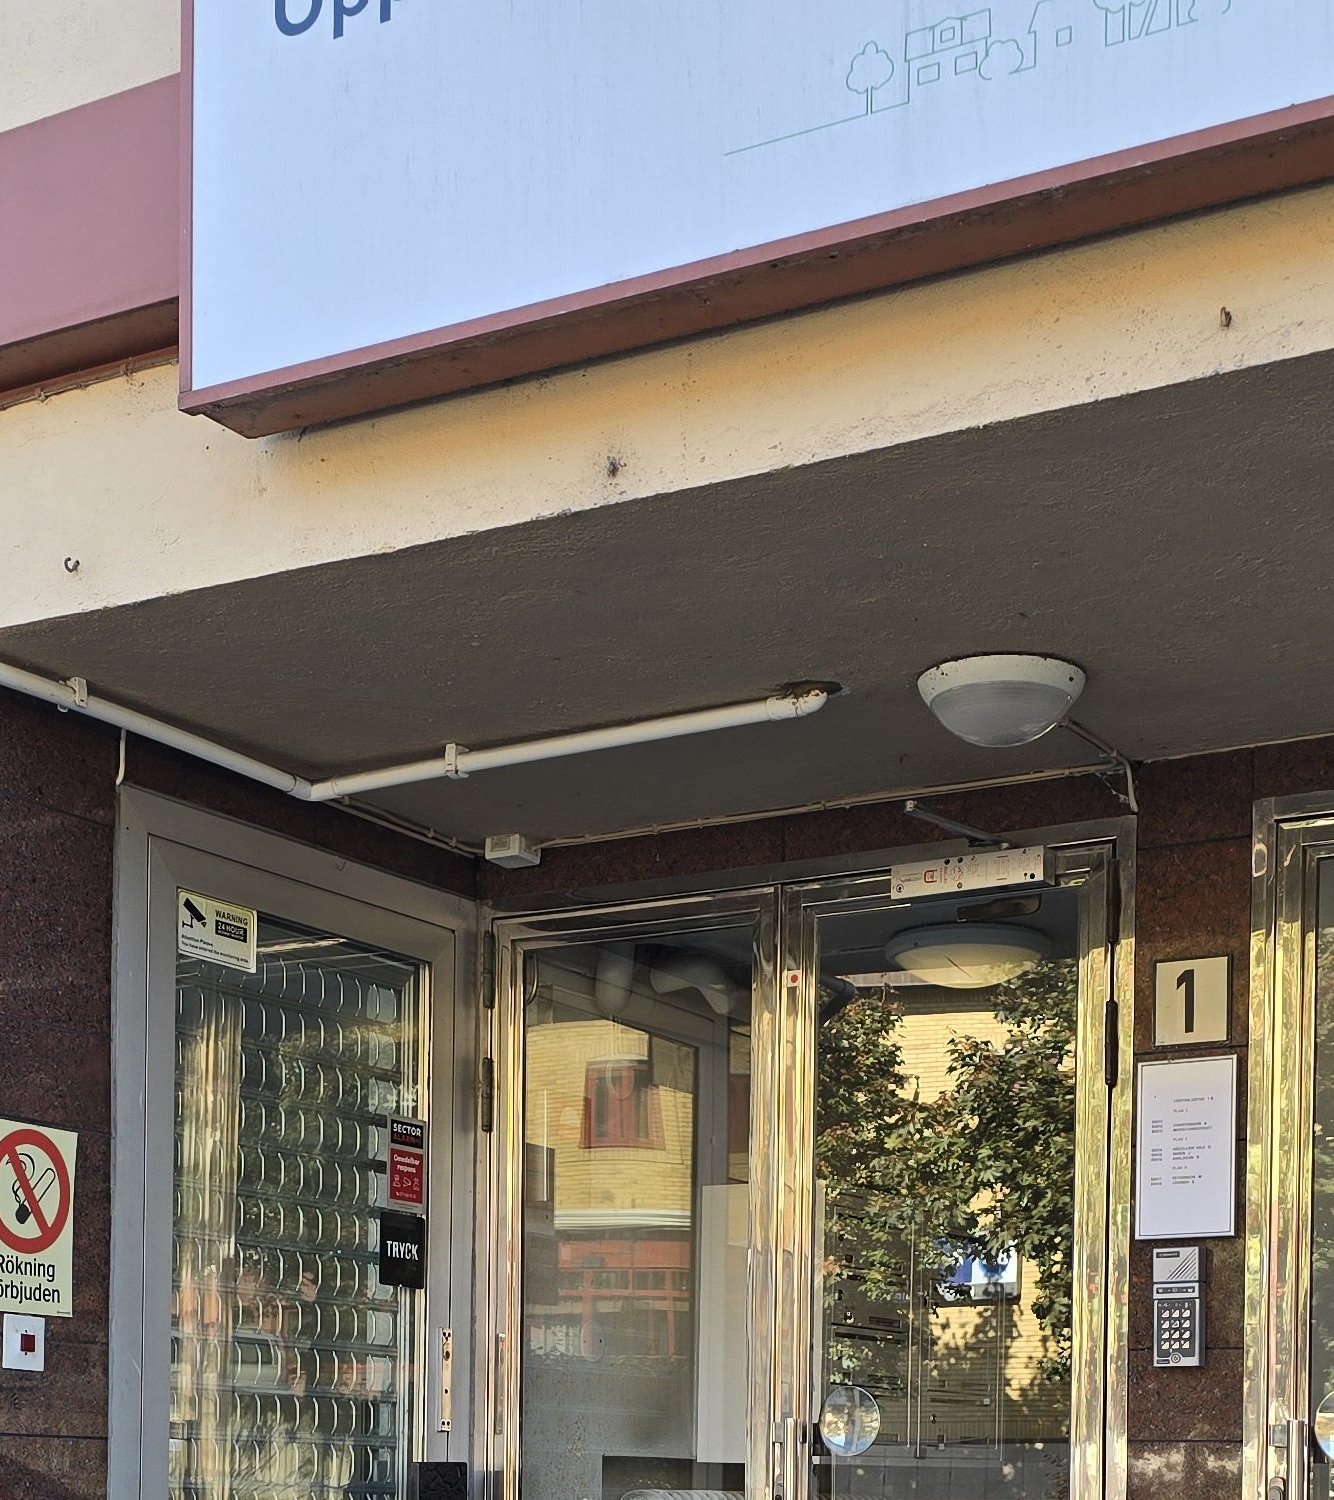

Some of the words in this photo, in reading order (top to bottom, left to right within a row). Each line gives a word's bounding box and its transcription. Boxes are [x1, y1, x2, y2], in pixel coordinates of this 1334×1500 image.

[215, 909, 248, 925] WARNING
[218, 922, 226, 930] 24
[226, 925, 244, 936] HOUR
[1175, 969, 1196, 1034] 1
[393, 1122, 422, 1137] SECTOR
[386, 1239, 419, 1262] TRYCK
